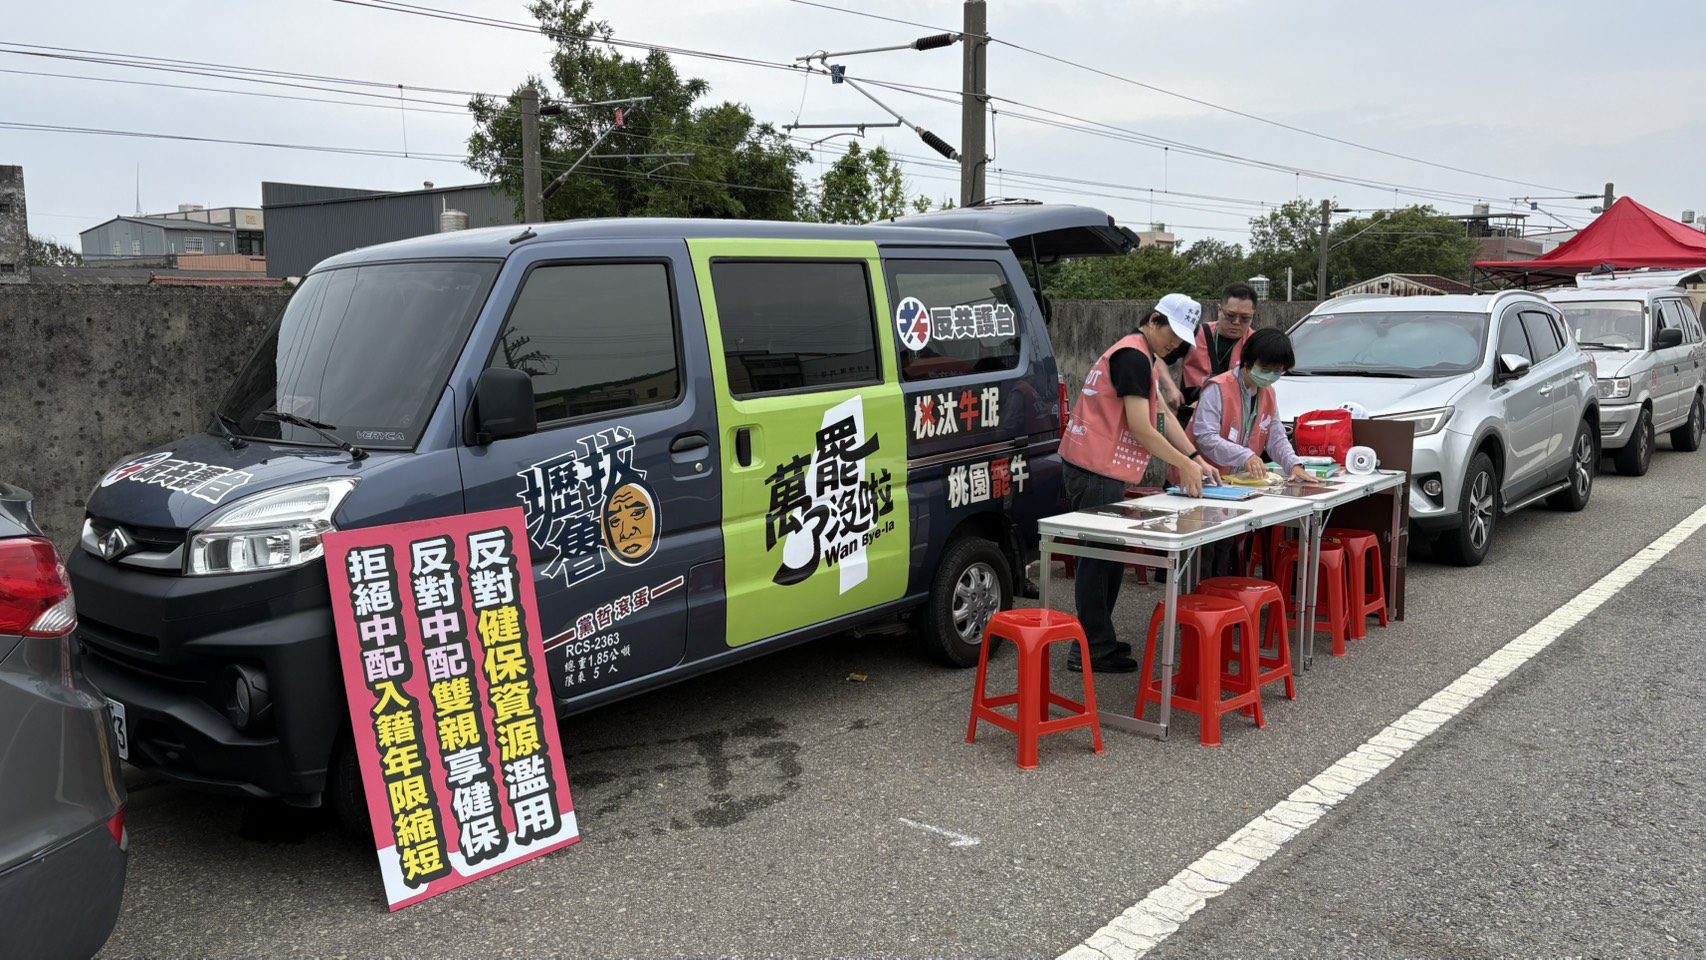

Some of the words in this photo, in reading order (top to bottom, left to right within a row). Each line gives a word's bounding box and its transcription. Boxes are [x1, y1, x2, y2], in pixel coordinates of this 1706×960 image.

[930, 304, 1015, 340] 反共護台
[356, 430, 405, 441] VERYCA
[948, 454, 1029, 508] 桃園罷牛
[824, 539, 858, 568] Wan
[861, 519, 895, 547] Bye-la
[565, 632, 620, 658] RCS-2363
[411, 538, 501, 858] 反對中配雙親享健保
[468, 530, 555, 838] 反對健保資源濫用
[348, 547, 444, 881] 拒絕中配入籍年限縮短
